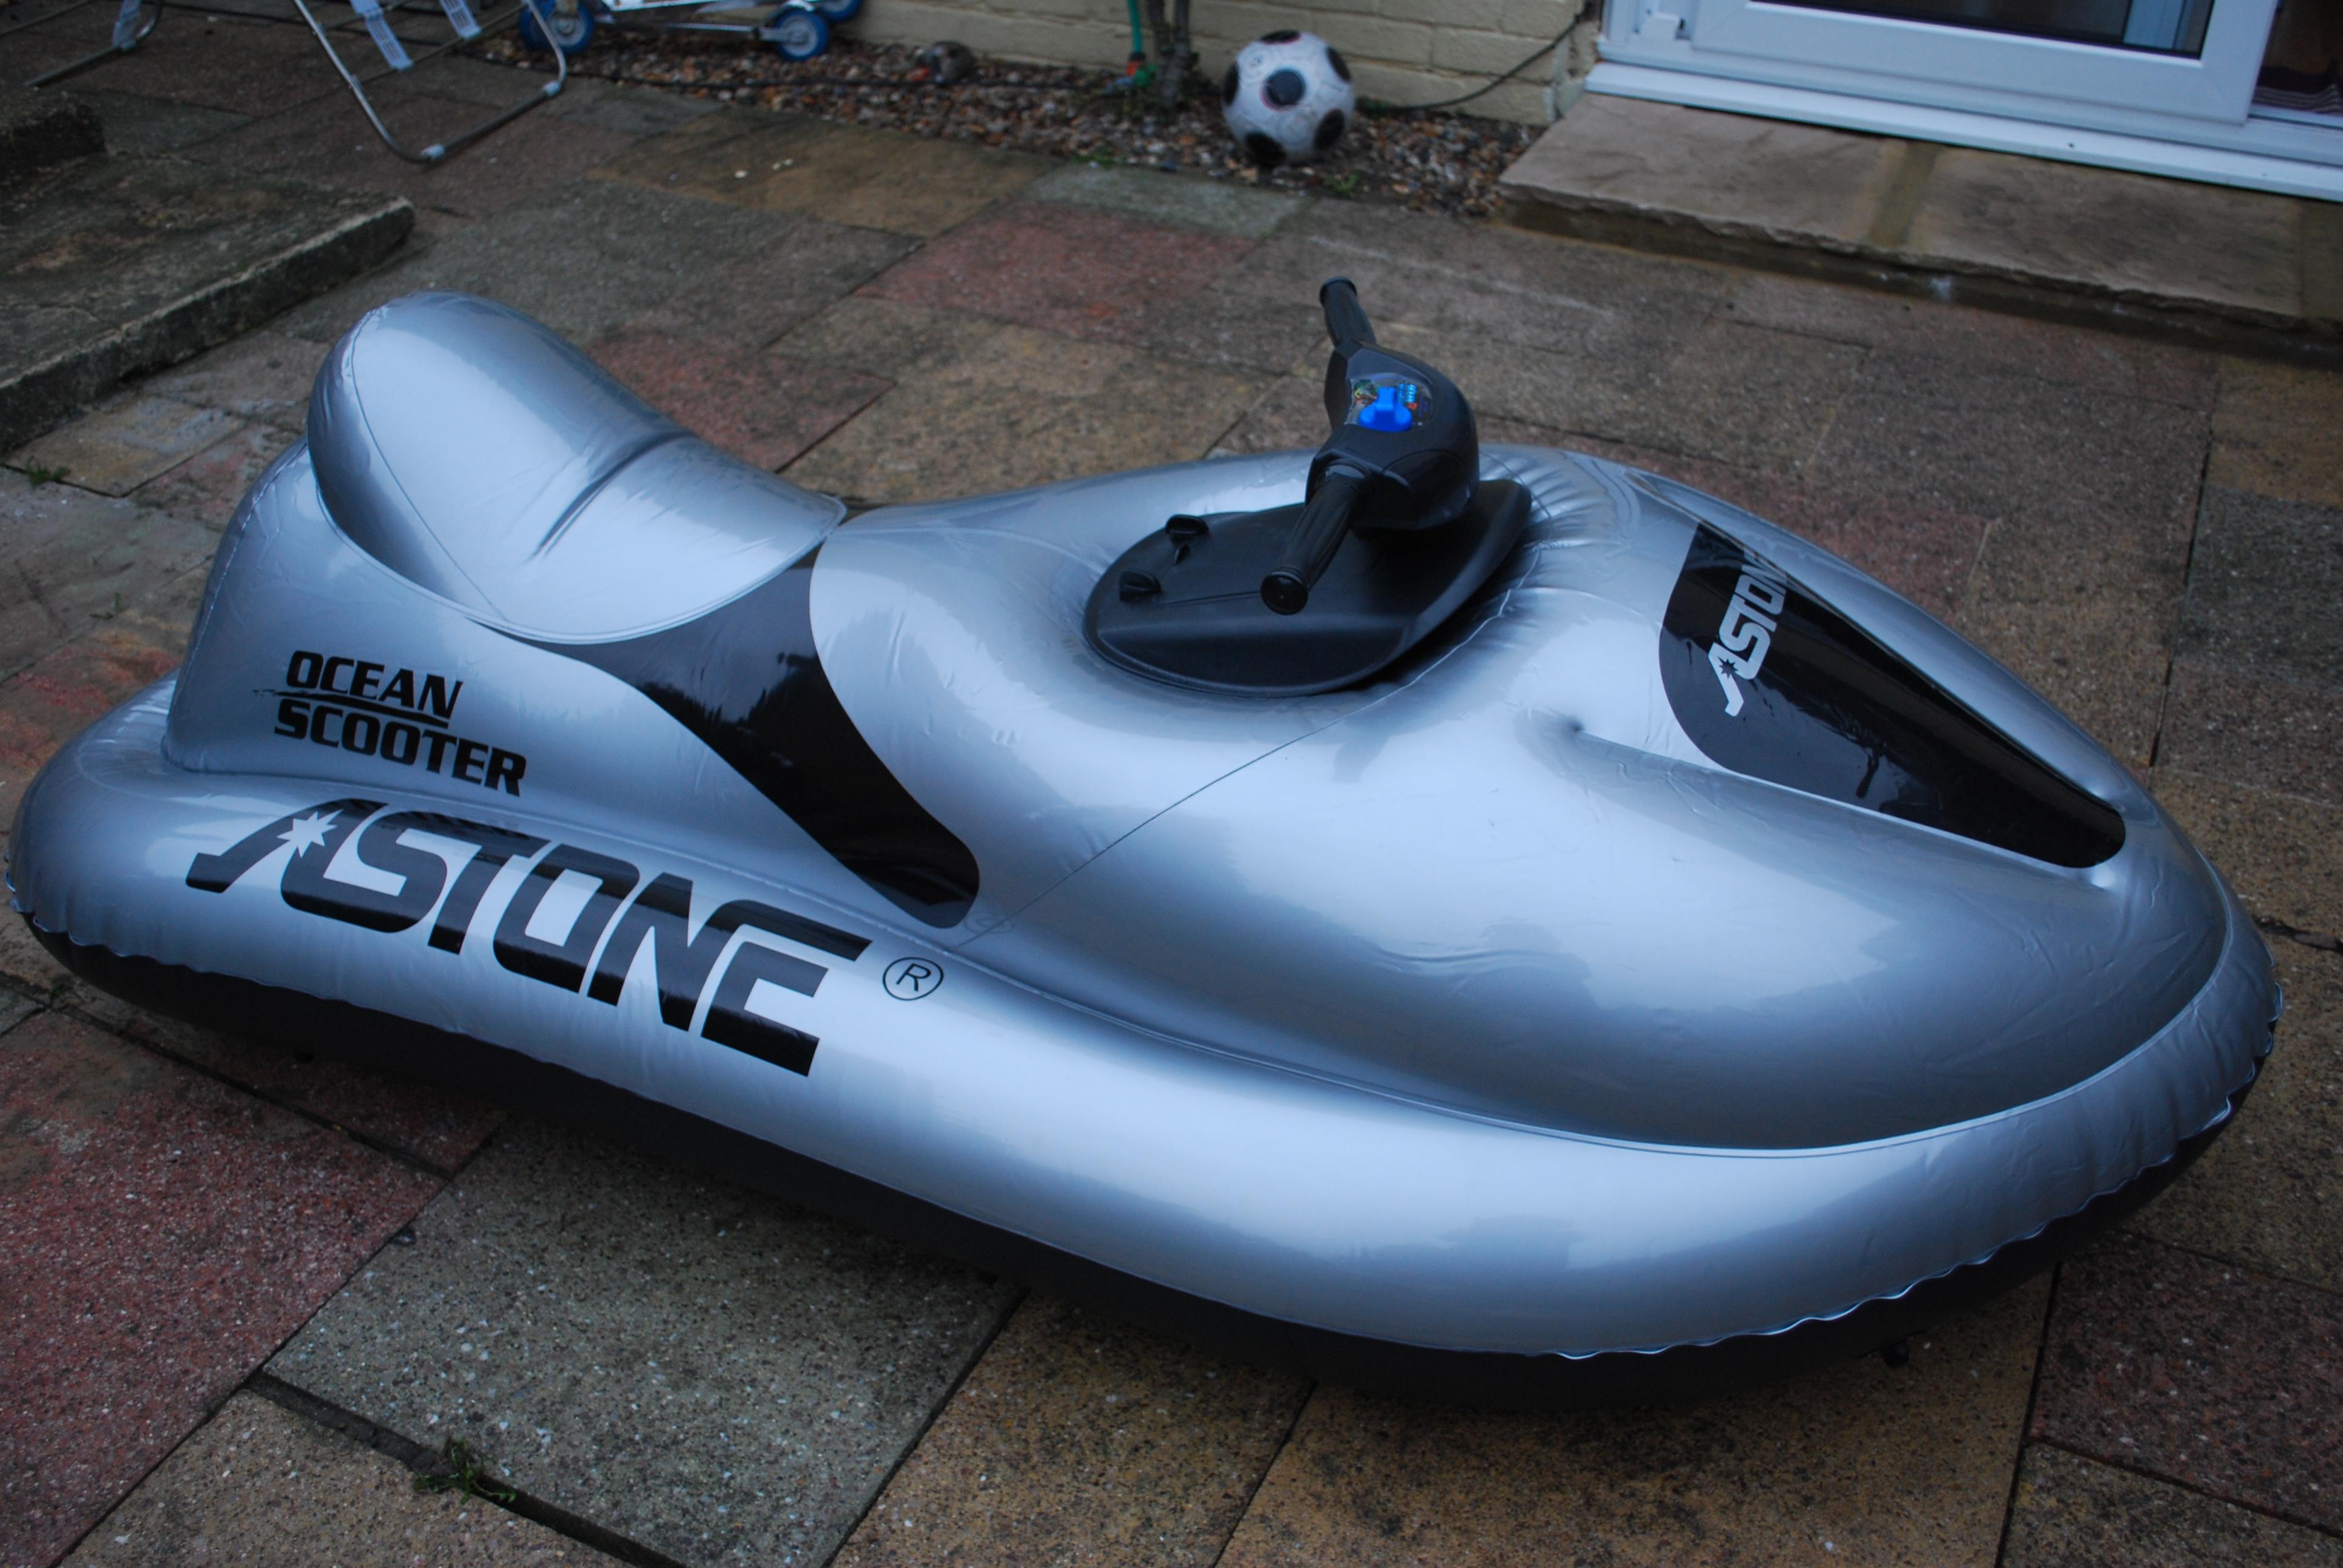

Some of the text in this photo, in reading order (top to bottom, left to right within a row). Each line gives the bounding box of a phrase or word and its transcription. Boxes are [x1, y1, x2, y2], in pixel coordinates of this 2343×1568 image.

[286, 649, 464, 719] OCEAN
[274, 698, 527, 797] SCOOTER
[185, 798, 873, 1077] ASTONE
